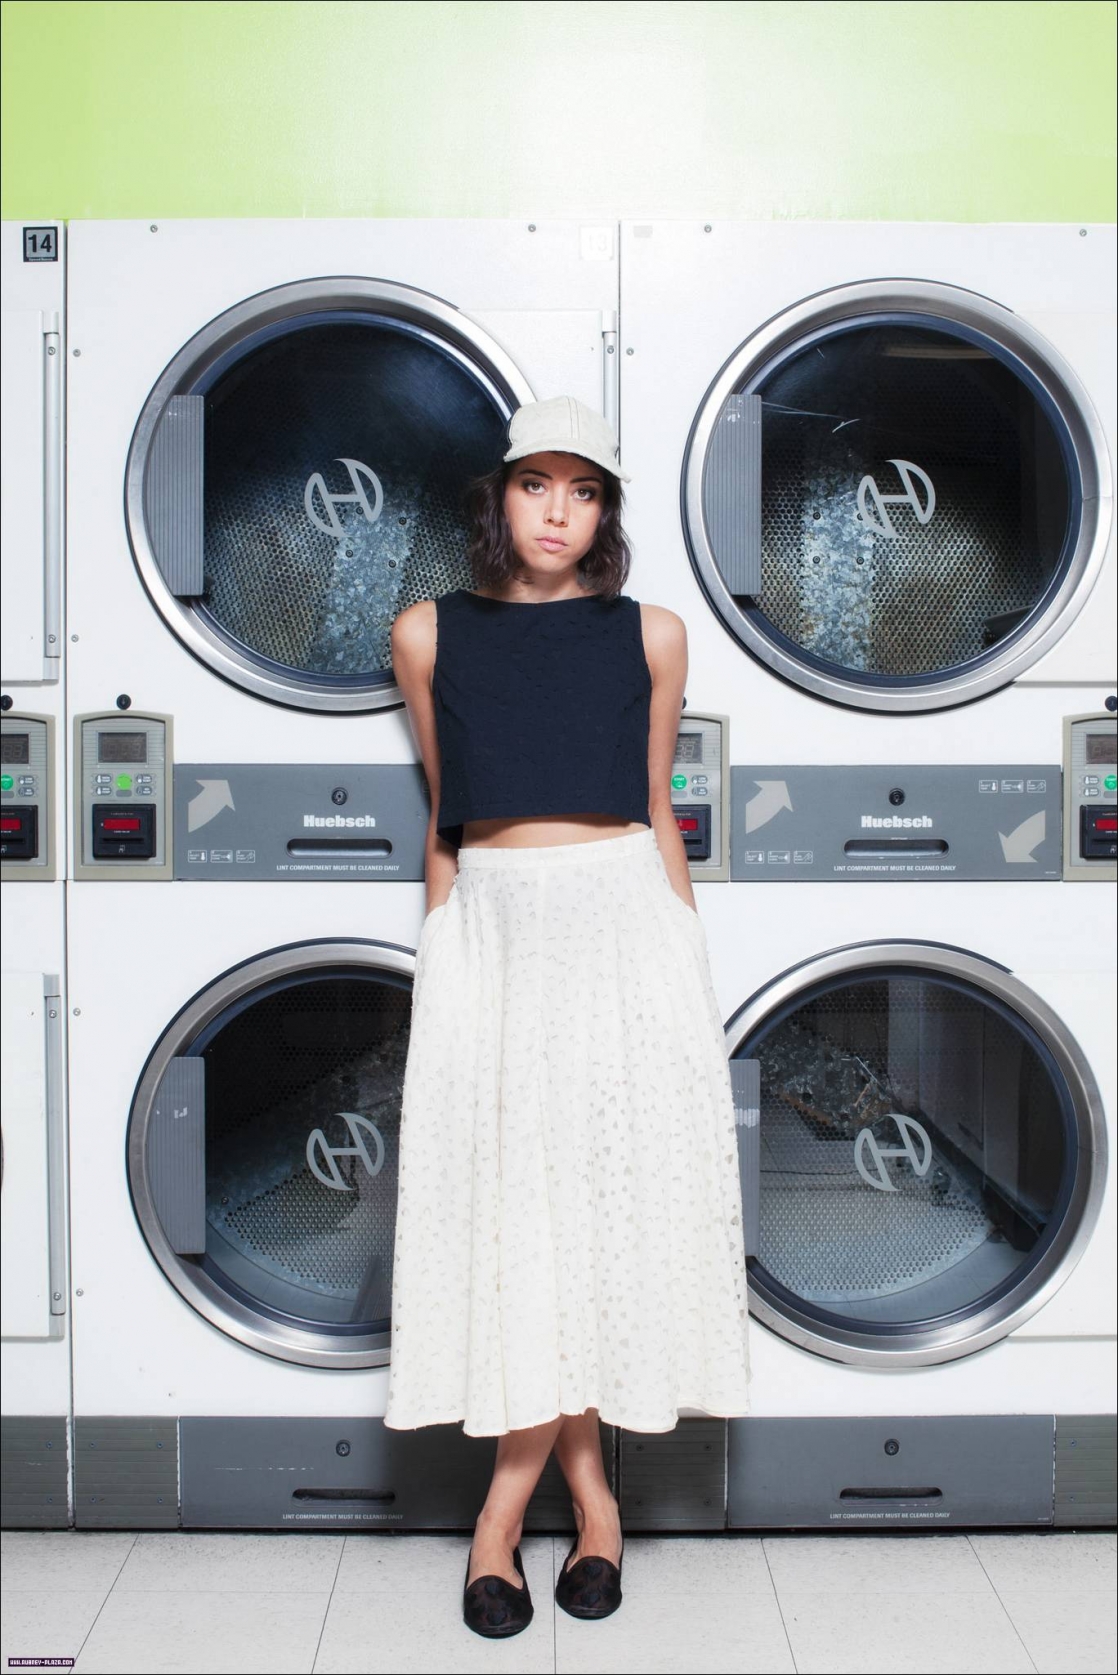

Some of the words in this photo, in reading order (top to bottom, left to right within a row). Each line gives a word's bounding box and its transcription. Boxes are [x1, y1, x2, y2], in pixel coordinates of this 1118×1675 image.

[28, 233, 52, 253] 14
[303, 814, 376, 828] Huebsch
[861, 815, 933, 828] Huebsch
